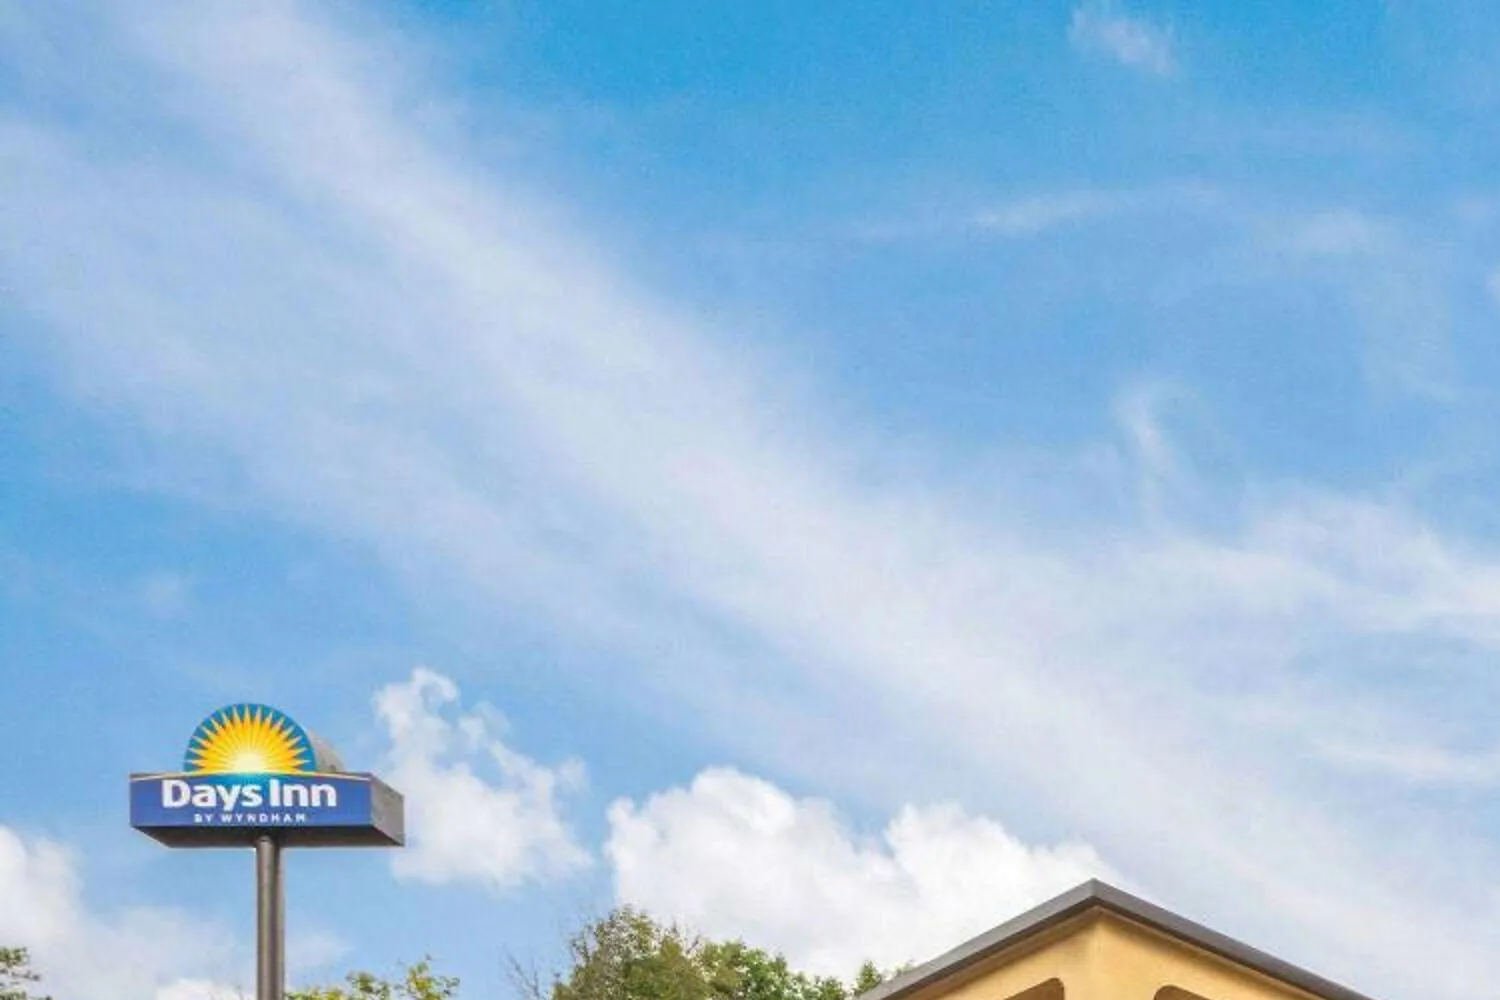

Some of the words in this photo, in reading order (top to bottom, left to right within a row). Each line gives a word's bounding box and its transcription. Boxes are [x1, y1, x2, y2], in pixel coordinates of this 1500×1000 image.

[162, 780, 262, 811] Days
[270, 779, 337, 807] Inn
[194, 814, 213, 823] BY
[221, 814, 306, 823] WYNDHAM
